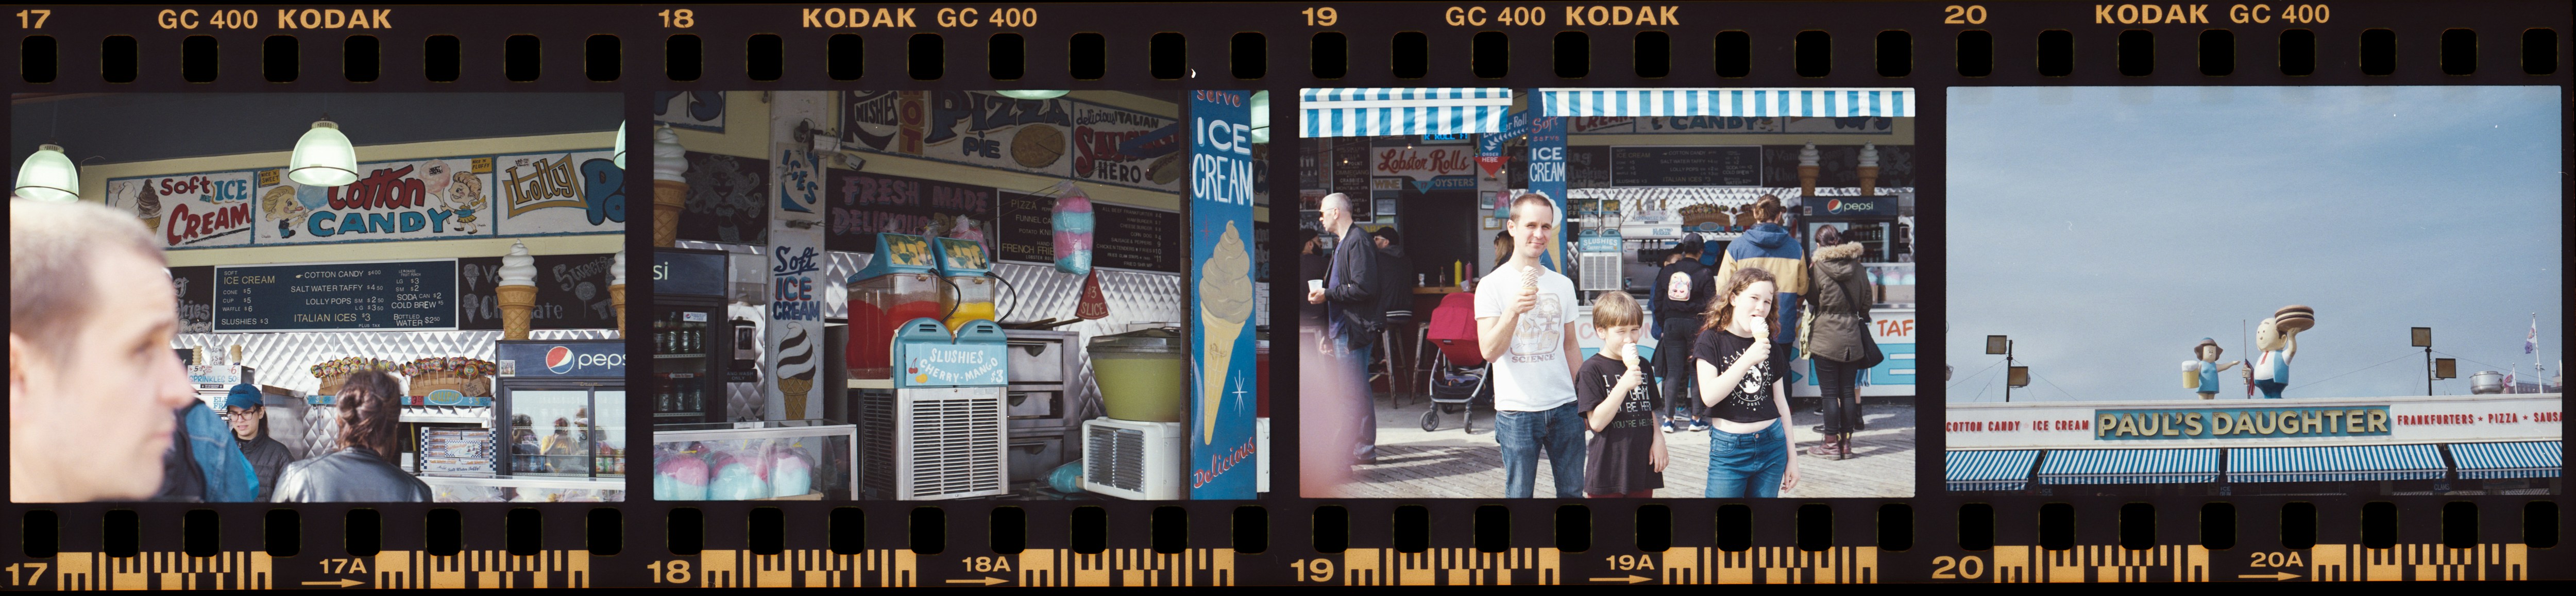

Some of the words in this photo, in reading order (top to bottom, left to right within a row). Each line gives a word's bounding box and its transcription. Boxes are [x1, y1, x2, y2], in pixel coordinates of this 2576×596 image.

[17, 10, 50, 29] 17
[159, 9, 198, 29] GC
[210, 10, 258, 29] 400
[279, 9, 392, 29] KODAK
[659, 9, 694, 28] 18
[803, 8, 917, 28] KODAK
[938, 8, 977, 27] GC
[990, 8, 1037, 27] 400
[1302, 7, 1337, 26] 19
[1446, 7, 1486, 26] GC
[1498, 7, 1546, 26] 400
[1567, 6, 1680, 26] KODAK
[1945, 6, 1987, 24] 20
[2096, 5, 2209, 24] KODAK
[2230, 4, 2270, 24] GC
[2282, 5, 2330, 24] 400
[924, 90, 1071, 144] PIZZA
[1114, 111, 1159, 128] ITALIAN
[1197, 116, 1251, 155] ICE
[1377, 148, 1428, 174] Lobster
[1428, 149, 1470, 175] Rolls
[1532, 147, 1563, 161] ICE
[1098, 161, 1141, 183] HERO
[1192, 154, 1254, 207] CREAM
[1530, 162, 1565, 182] CREAM
[160, 176, 210, 196] Soft
[214, 179, 247, 202] ICE
[506, 158, 574, 206] Lolly
[1373, 179, 1400, 189] WINE
[1435, 178, 1475, 188] OYSTERS
[841, 175, 921, 206] FRESH
[932, 185, 989, 214] MADE
[1011, 199, 1037, 210] PIZZA
[1843, 201, 1874, 212] pepsi
[167, 202, 250, 246] CREAM
[308, 208, 452, 237] CANDY
[1015, 214, 1042, 223] FUNNEL
[1002, 243, 1035, 254] FRENCH
[1583, 238, 1618, 246] SLUSHIES
[242, 276, 275, 284] CREAM
[775, 276, 812, 301] ICE
[294, 314, 331, 322] ITALIAN
[335, 314, 357, 322] ICES
[362, 313, 370, 321] $3
[773, 300, 820, 322] CREAM
[1081, 301, 1107, 317] SLICE
[1876, 319, 1914, 337] TAF
[578, 353, 625, 370] pep
[929, 347, 984, 364] SLUSHIES
[990, 369, 1004, 384] $3
[1946, 421, 1982, 433] COTTON
[1988, 420, 2021, 432] CANDY
[2032, 420, 2049, 431] ICE
[2055, 420, 2089, 431] CREAM
[2098, 412, 2204, 437] PAUL'S
[2212, 408, 2388, 435] DAUGHTER
[2397, 414, 2474, 426] FRANKFURTERS
[2488, 413, 2518, 424] PIZZA
[1193, 436, 1256, 489] Delicious
[319, 558, 367, 574] 17A
[962, 556, 1011, 572] 18A
[1606, 554, 1655, 571] 19A
[1932, 555, 1984, 580] 20
[2250, 552, 2303, 568] 20A
[6, 563, 47, 586] 17
[647, 559, 691, 584] 18
[1291, 558, 1334, 582] 19
